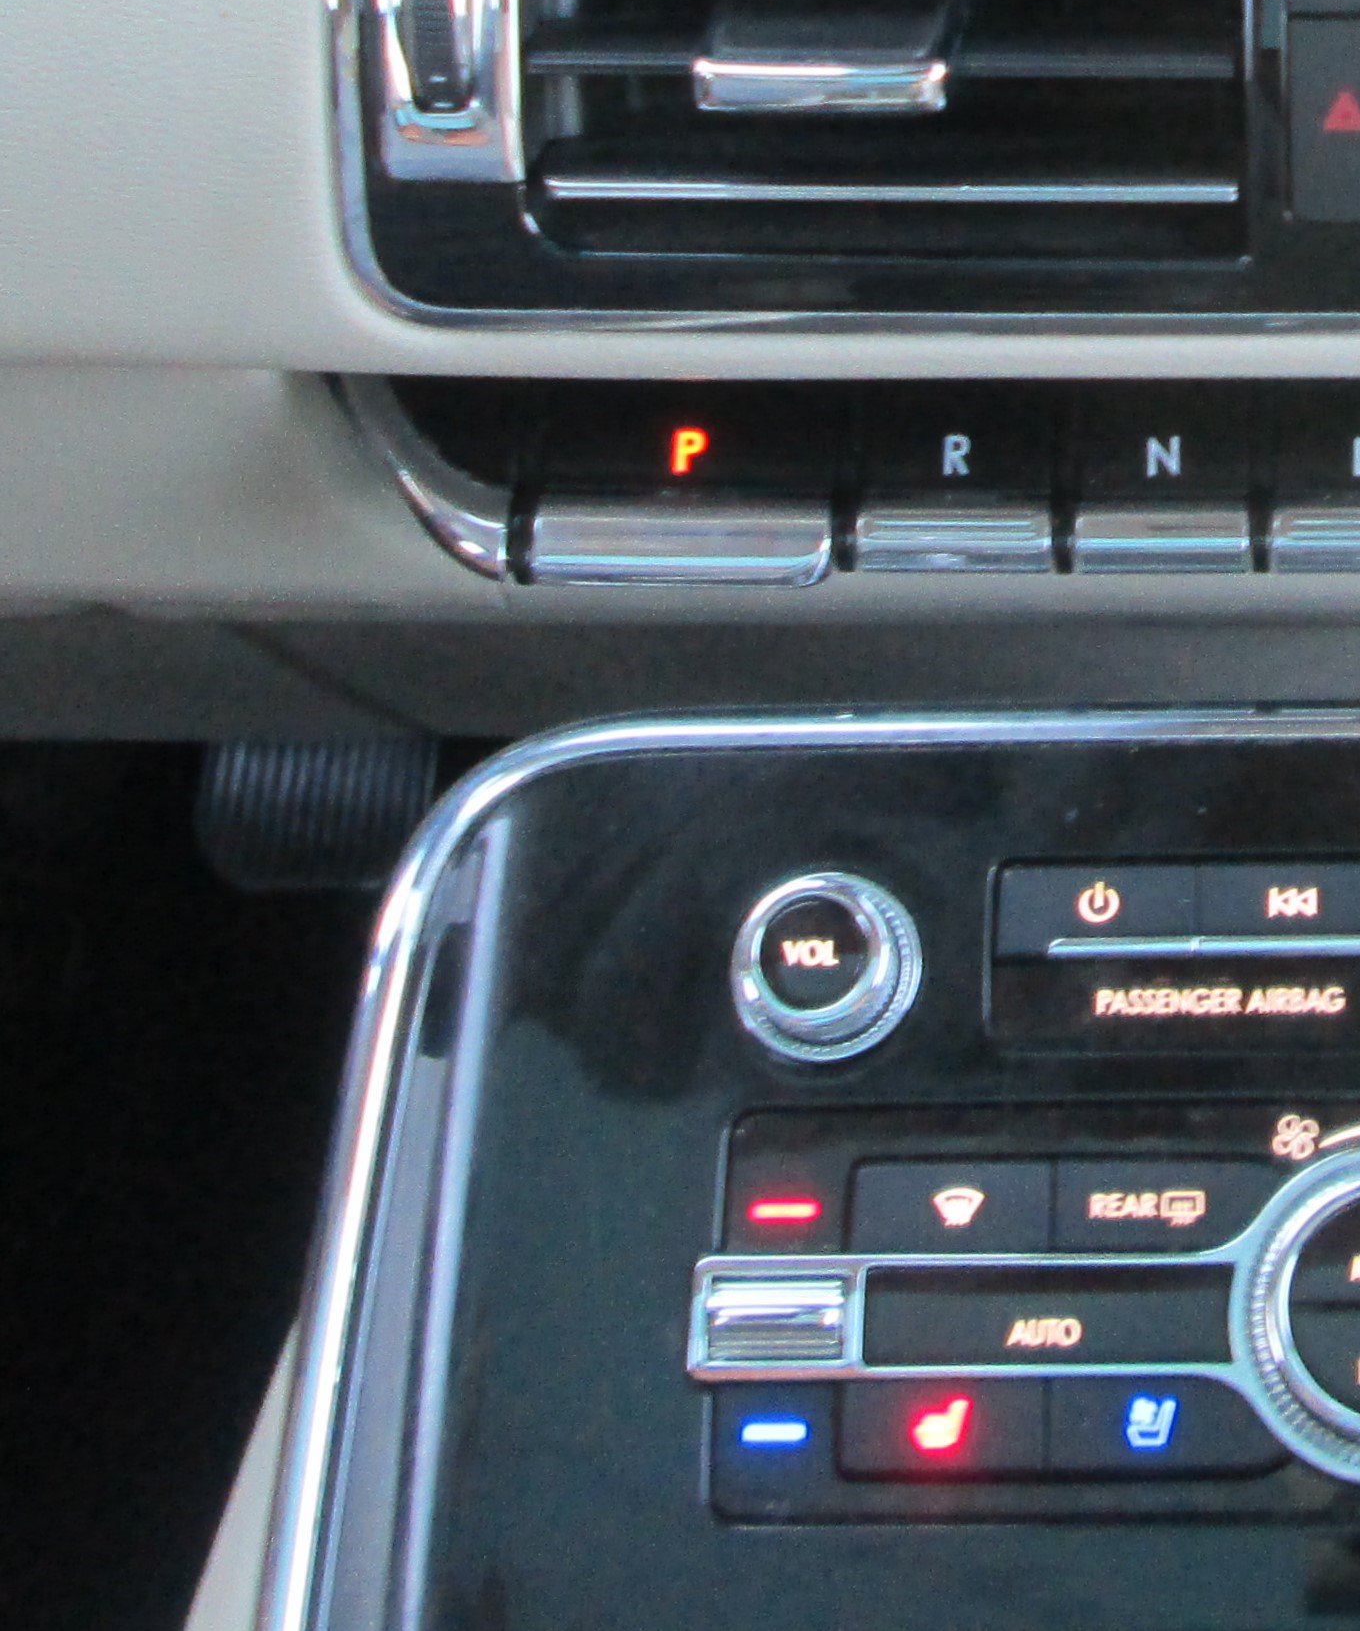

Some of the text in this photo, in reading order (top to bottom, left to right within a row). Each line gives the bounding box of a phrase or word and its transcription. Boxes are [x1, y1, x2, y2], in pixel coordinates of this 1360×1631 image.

[668, 427, 708, 475] P
[942, 434, 971, 477] R
[1146, 435, 1183, 478] N
[781, 939, 839, 968] VOL
[1094, 988, 1242, 1017] PASSENGER
[1244, 986, 1346, 1015] AIRBAG
[1087, 1190, 1157, 1220] REAR
[1006, 1319, 1082, 1349] AUTO
